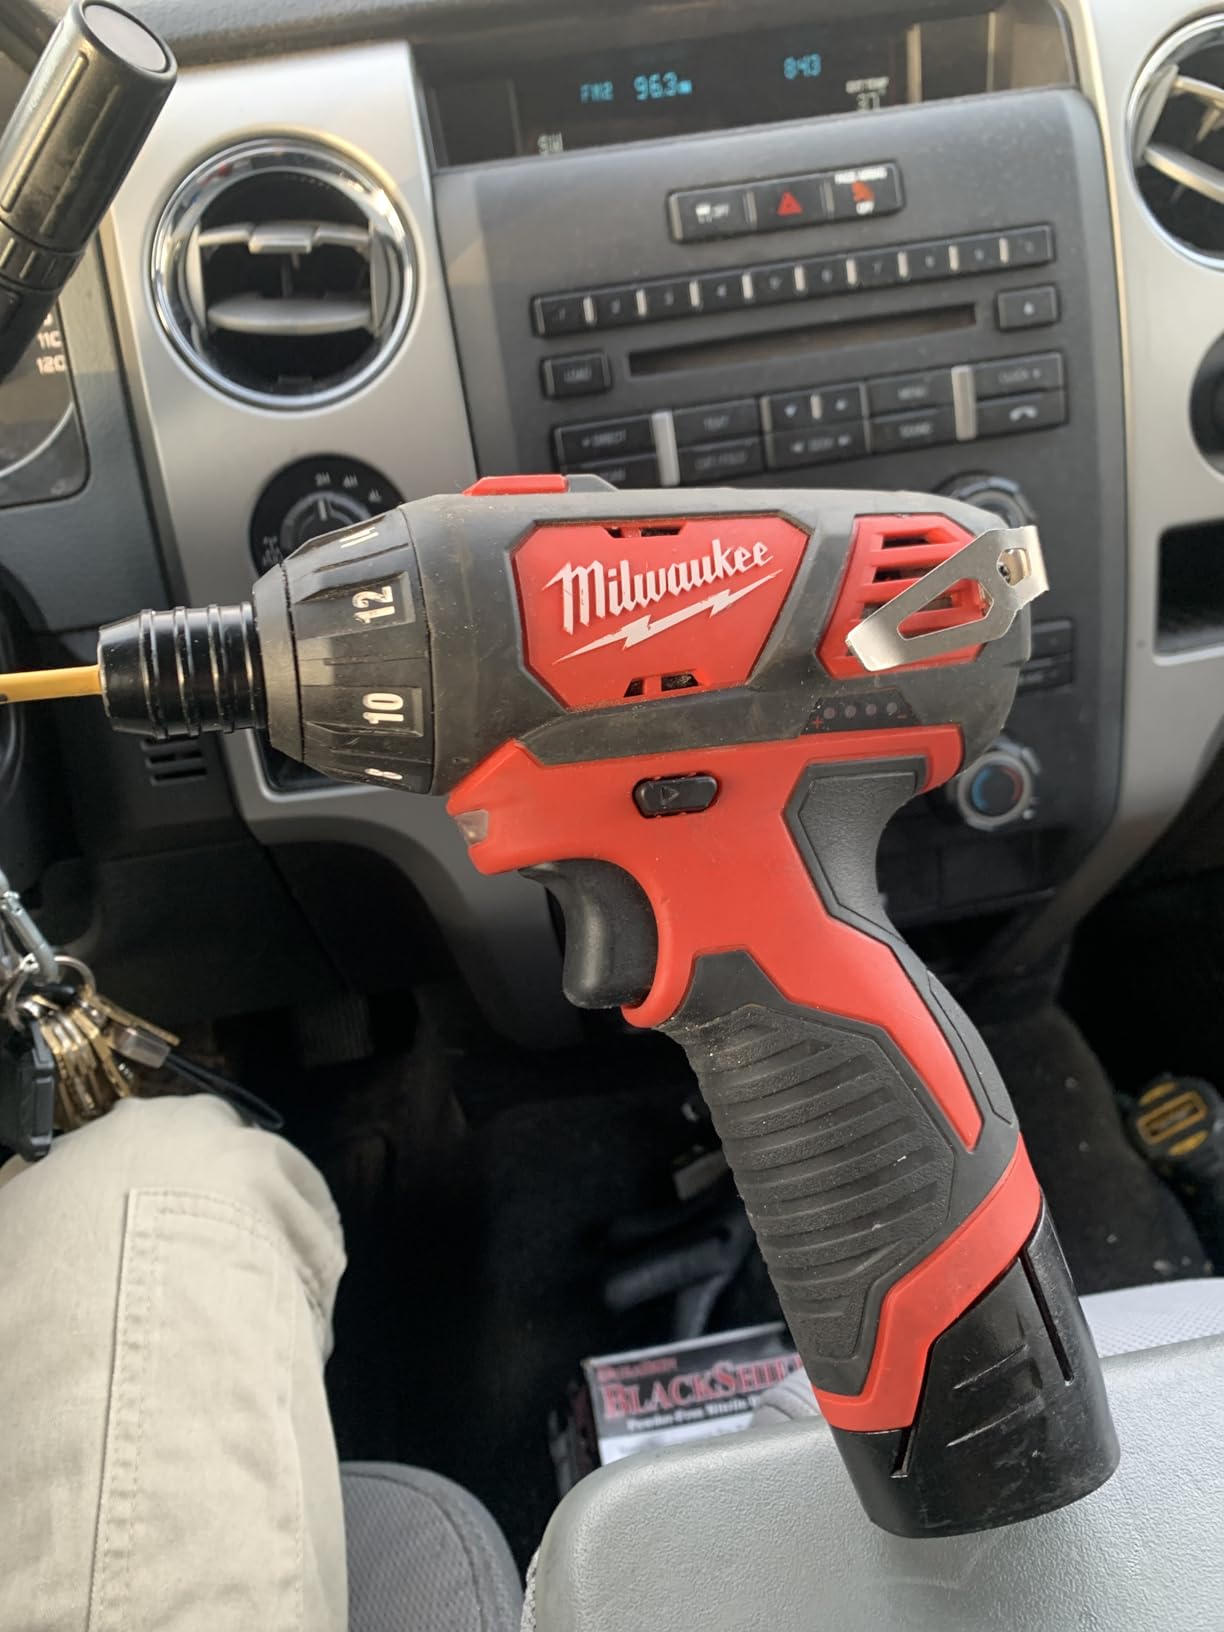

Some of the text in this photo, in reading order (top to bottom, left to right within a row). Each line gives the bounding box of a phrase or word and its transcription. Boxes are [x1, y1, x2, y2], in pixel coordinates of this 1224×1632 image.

[352, 586, 396, 623] 12
[541, 538, 774, 635] Milwaukee
[363, 693, 404, 725] 10
